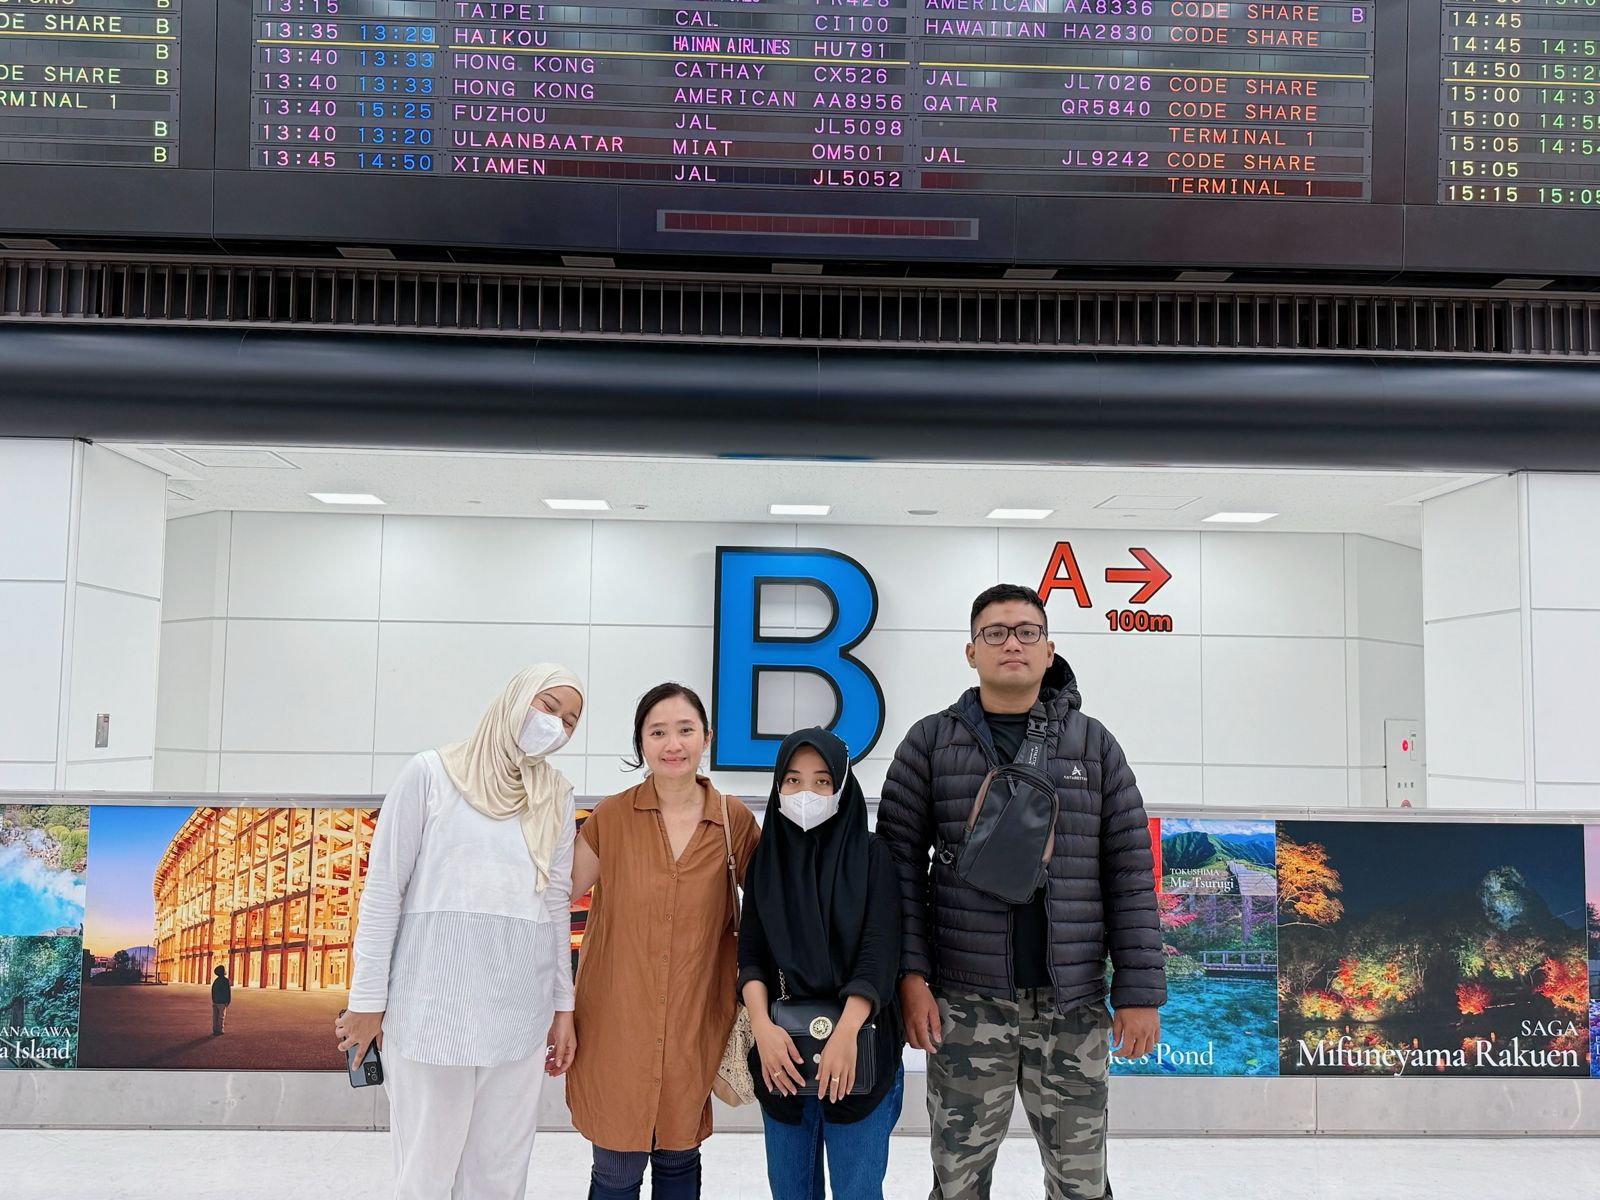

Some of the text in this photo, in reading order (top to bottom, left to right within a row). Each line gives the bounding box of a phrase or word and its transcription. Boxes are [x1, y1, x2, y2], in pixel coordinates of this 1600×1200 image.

[924, 0, 1363, 22] AMERICAN AA8336 CODE SHARE B
[1454, 12, 1521, 28] 14:45
[45, 15, 121, 32] SHARE
[157, 19, 169, 33] B
[268, 0, 1318, 46] 13:15 TAIPEI CAL CI100 HAWAIIAN HA2830 CODE SHARE
[266, 23, 886, 58] 13:35 13:29 HAIKOU HAINAN AIRLINES HU791
[1453, 37, 1520, 53] 14:45
[157, 44, 168, 59] B
[45, 66, 120, 83] SHARE
[156, 70, 168, 85] B
[265, 49, 1317, 95] 13:40 13:33 HONG KONG CATHAY CX526 JAL JL7026 CODE SHARE
[1452, 62, 1600, 80] 14:50 15:2
[110, 94, 116, 109] 1
[265, 74, 1316, 121] 13:40 13:33 HONG KONG AMERICAN AA8956 QATAR QR5840 CODE SHARE
[1452, 87, 1600, 105] 15:00 14:3
[155, 121, 167, 136] B
[264, 100, 1312, 145] 13:40 15:25 FUZHOU JAL JL5098 TERMINAL 1
[1451, 111, 1600, 129] 15:00 14:5
[264, 125, 1315, 171] 13:40 13:20 ULAANBAATAR MIAT OM501 JAL JL9242 CODE SHARE
[1451, 137, 1518, 152] 15:05
[155, 147, 166, 162] B
[263, 151, 1311, 195] 13:45 14:50 XIAMEN JAL JL5052 TERMINAL 1
[1450, 161, 1518, 177] 15:05
[1450, 186, 1517, 201] 15:15
[1035, 541, 1092, 608] A
[1106, 610, 1173, 632] 100m
[711, 546, 886, 772] B
[1170, 868, 1219, 876] TOKUSHIMA
[1170, 877, 1234, 893] Mt. Tsurugi
[1521, 1020, 1579, 1036] SAGA
[15, 1039, 70, 1059] Island
[1156, 1040, 1214, 1066] Pond
[1296, 1036, 1467, 1078] Mifuneyama
[1475, 1037, 1580, 1067] Rakuen
